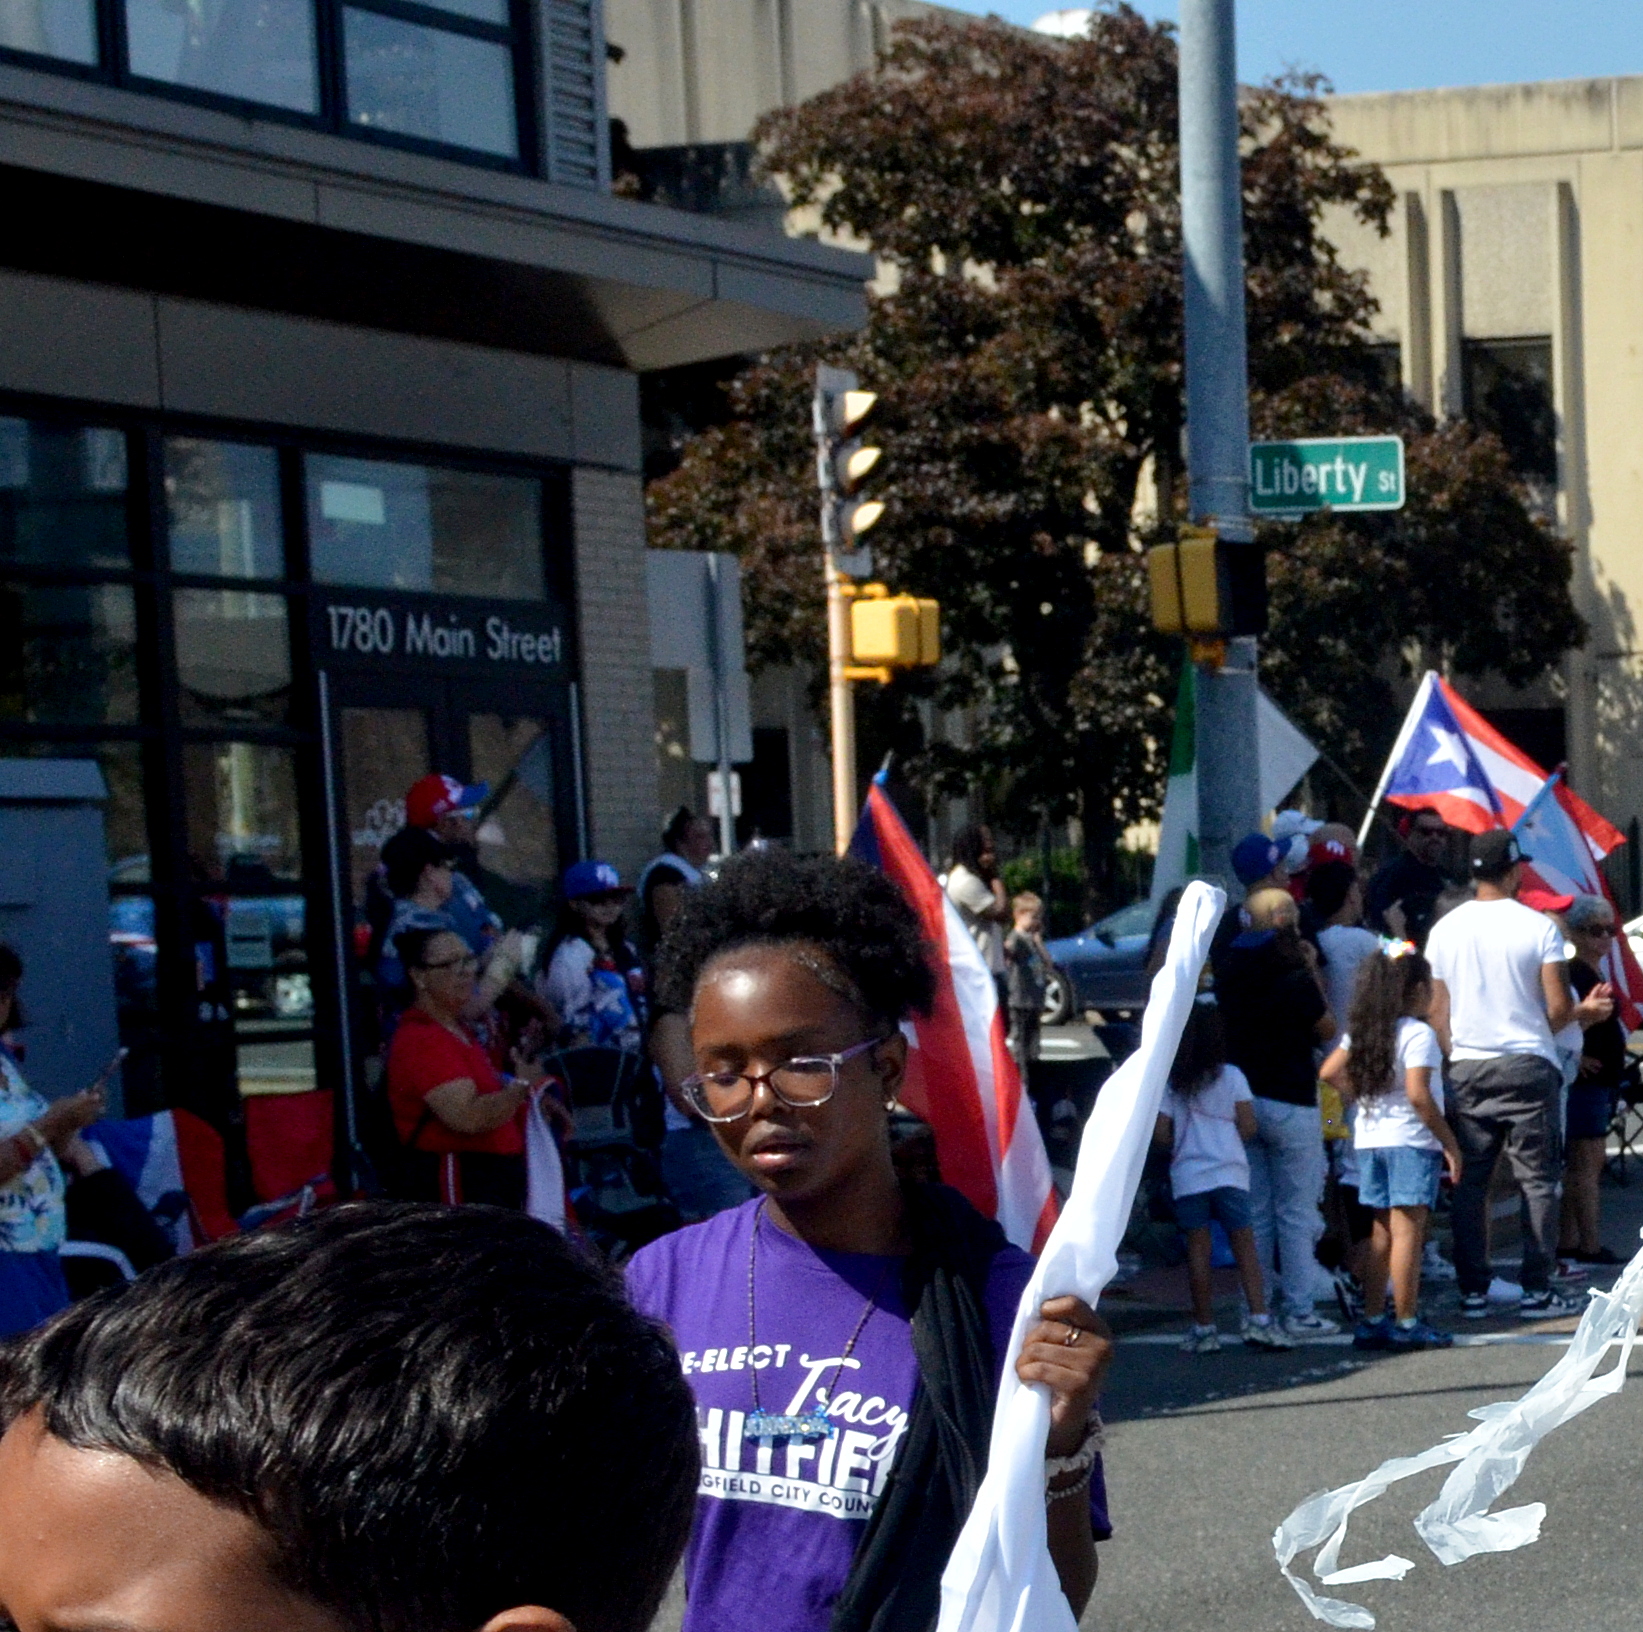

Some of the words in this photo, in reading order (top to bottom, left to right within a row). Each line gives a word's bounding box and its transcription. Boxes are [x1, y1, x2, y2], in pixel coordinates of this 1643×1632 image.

[1256, 456, 1368, 503] Liberty
[1379, 470, 1397, 493] St
[328, 605, 395, 653] 1780
[406, 612, 475, 657] Main
[486, 616, 562, 662] Street
[681, 1343, 792, 1375] E-ELECT
[785, 1353, 910, 1462] Tracy
[701, 1473, 762, 1495] GFIELD
[771, 1482, 812, 1504] CITY
[819, 1491, 872, 1514] COUN
